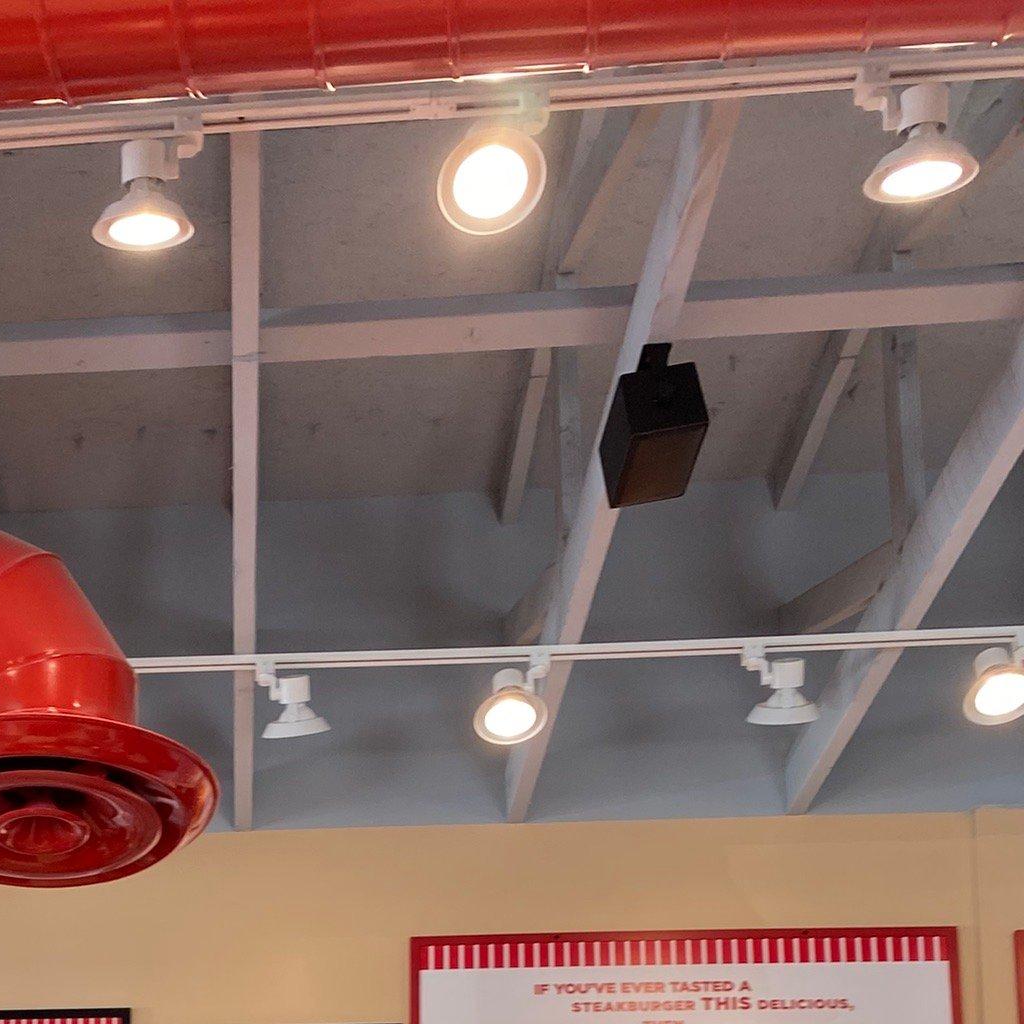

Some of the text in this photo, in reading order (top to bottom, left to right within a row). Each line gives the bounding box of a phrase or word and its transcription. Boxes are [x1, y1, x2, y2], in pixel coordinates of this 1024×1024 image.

[534, 980, 752, 995] IF YOU'VE EVER TASTED A
[571, 997, 855, 1012] STEAKBURGER THIS DELICIOUS,
